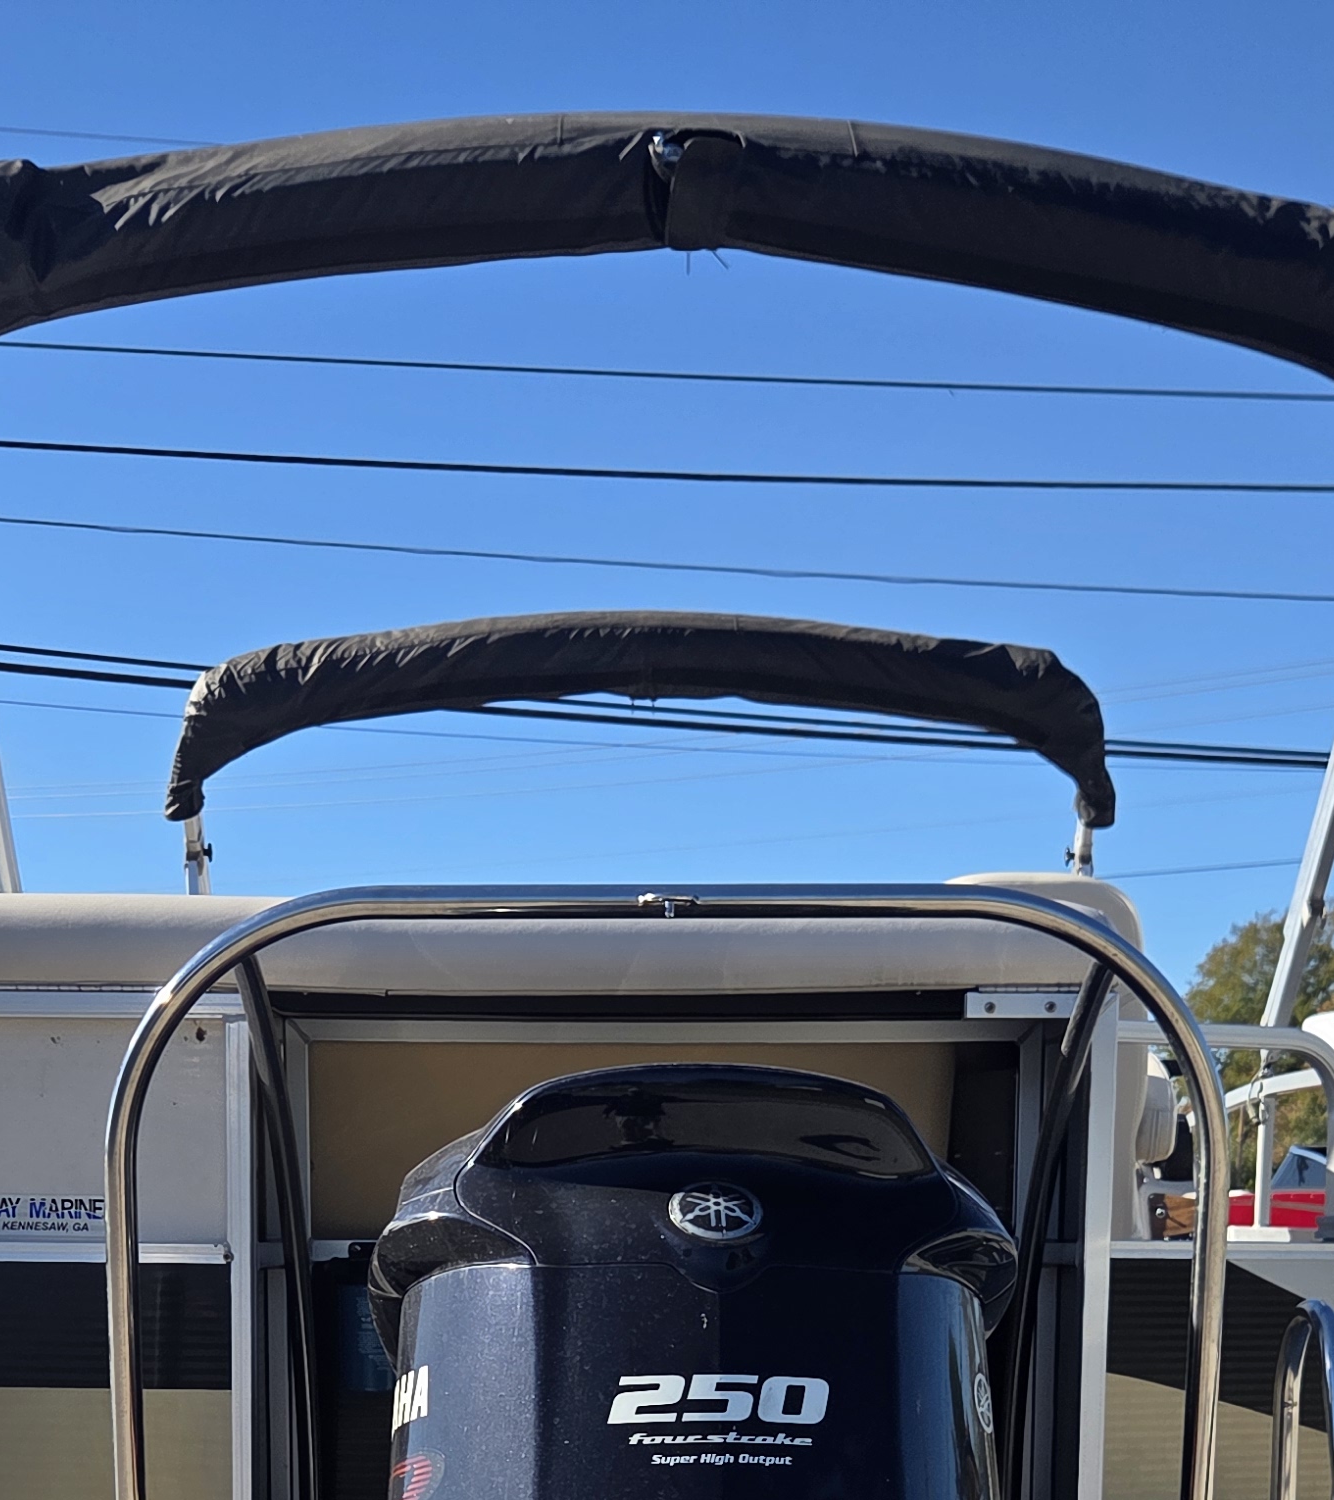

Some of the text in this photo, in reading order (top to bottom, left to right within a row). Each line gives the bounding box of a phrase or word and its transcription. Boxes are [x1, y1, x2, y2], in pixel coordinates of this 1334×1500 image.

[29, 1197, 105, 1220] MARINE
[2, 1221, 90, 1233] KENNESAW, GA
[607, 1374, 830, 1425] 250
[651, 1453, 793, 1467] Super High Output
